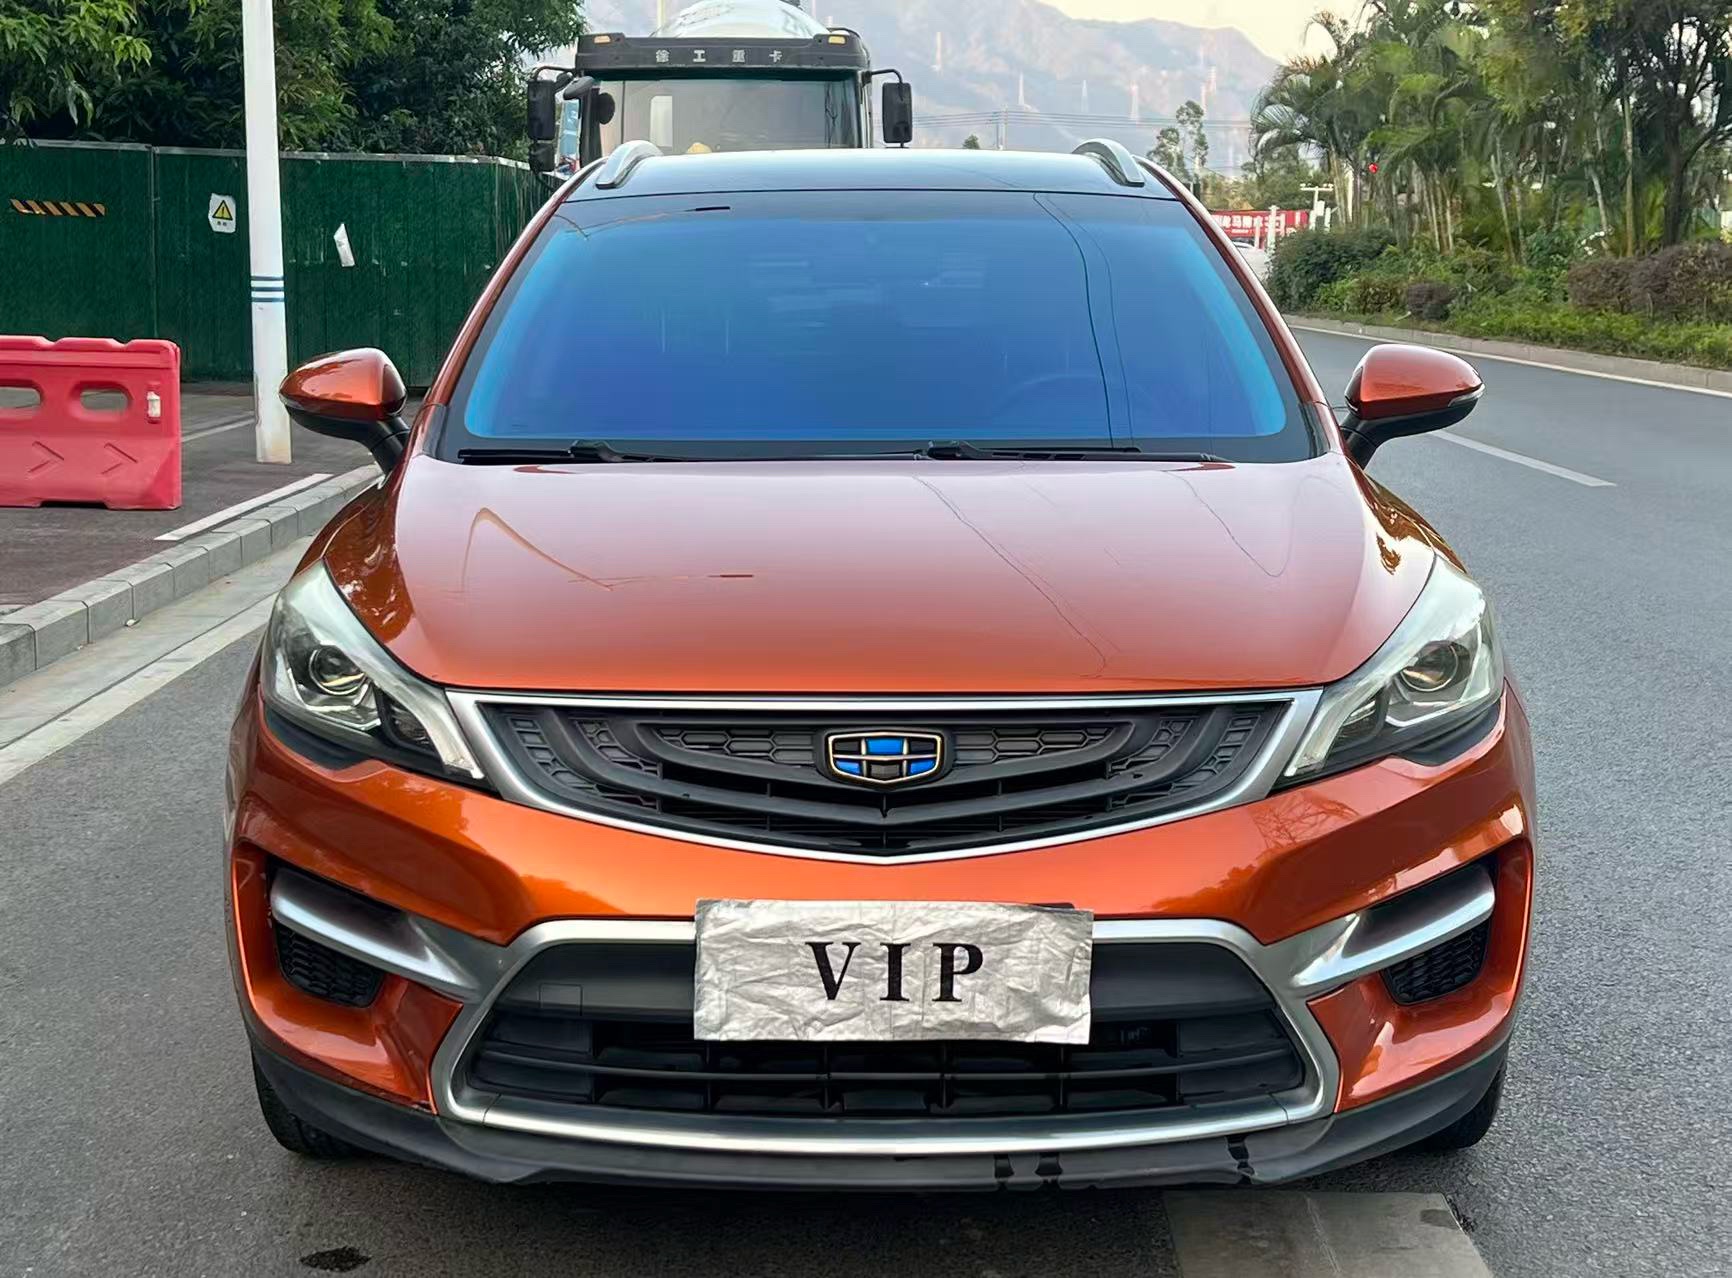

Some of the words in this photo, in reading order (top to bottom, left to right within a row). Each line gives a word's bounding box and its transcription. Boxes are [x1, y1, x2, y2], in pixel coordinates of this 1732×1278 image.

[655, 49, 782, 63] 徐工重卡
[805, 941, 984, 1002] VIP
